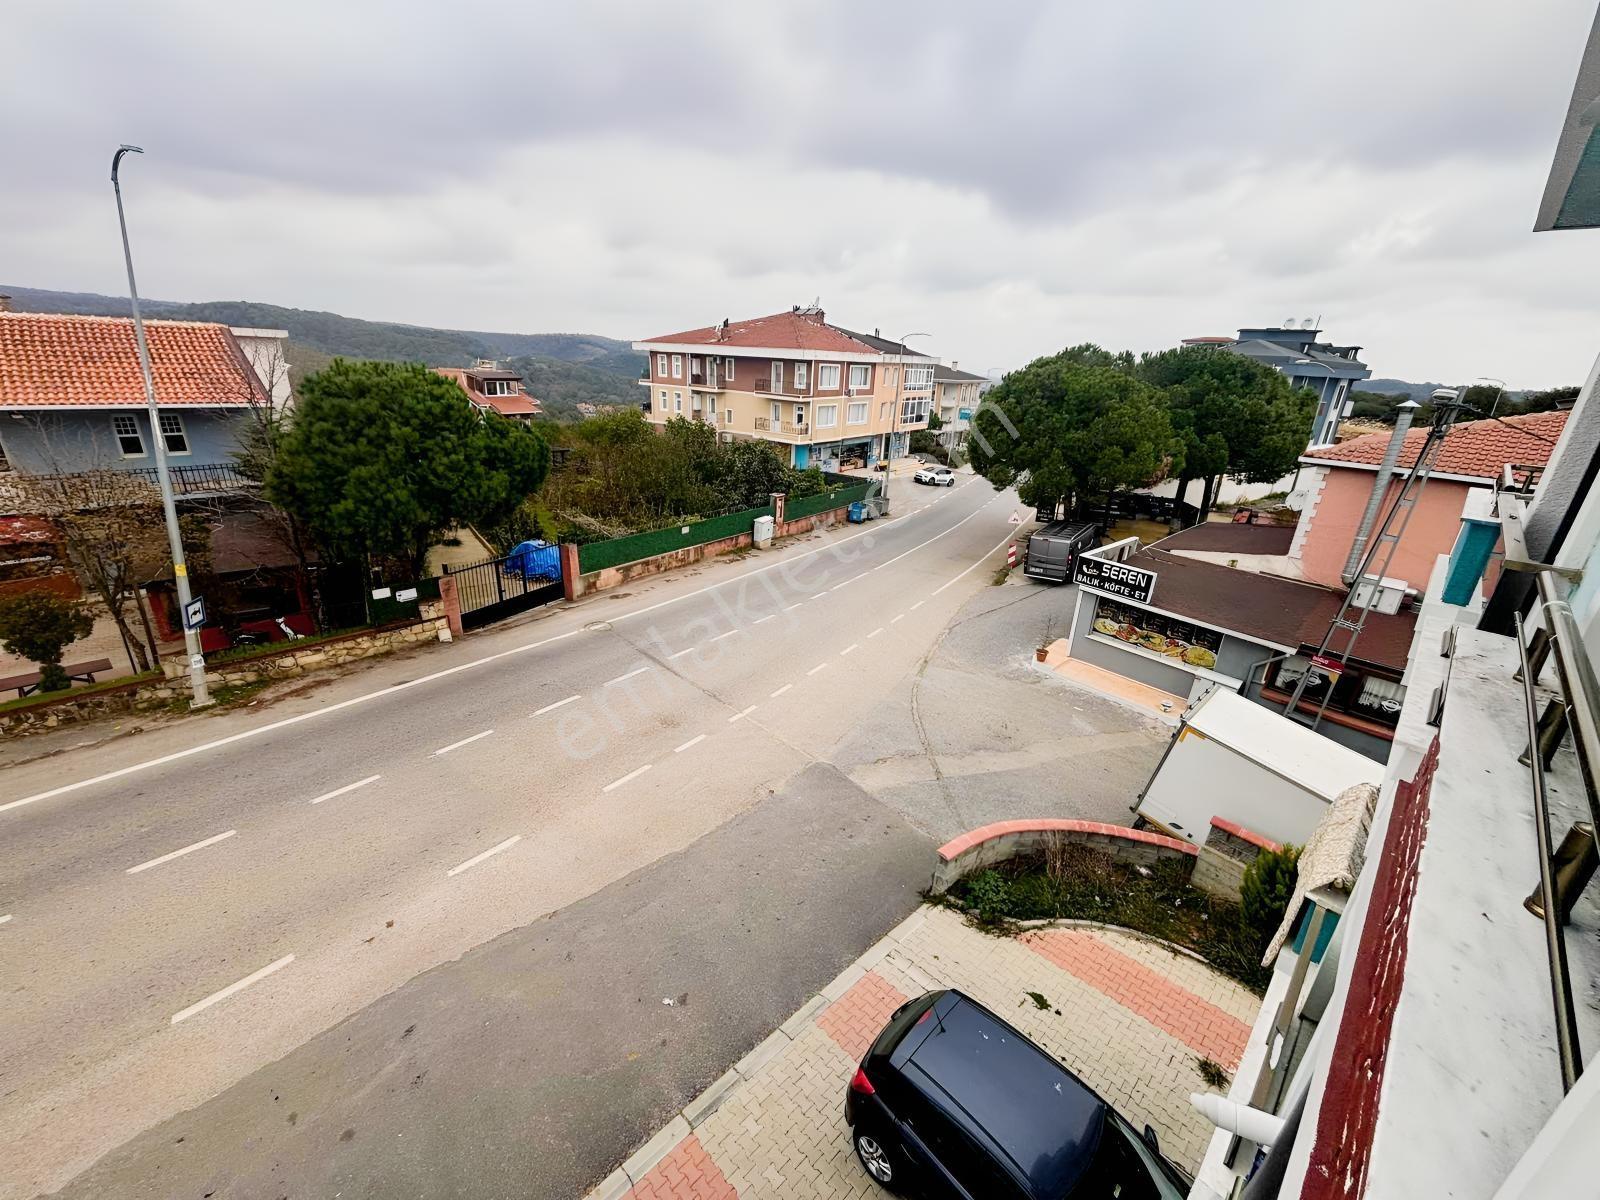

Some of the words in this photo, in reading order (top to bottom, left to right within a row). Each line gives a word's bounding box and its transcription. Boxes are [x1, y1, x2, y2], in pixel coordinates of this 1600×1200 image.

[1077, 574, 1100, 587] BALIK
[1104, 581, 1131, 596] KÖFTE
[1134, 591, 1146, 600] ET
[1101, 564, 1148, 587] SEREN
